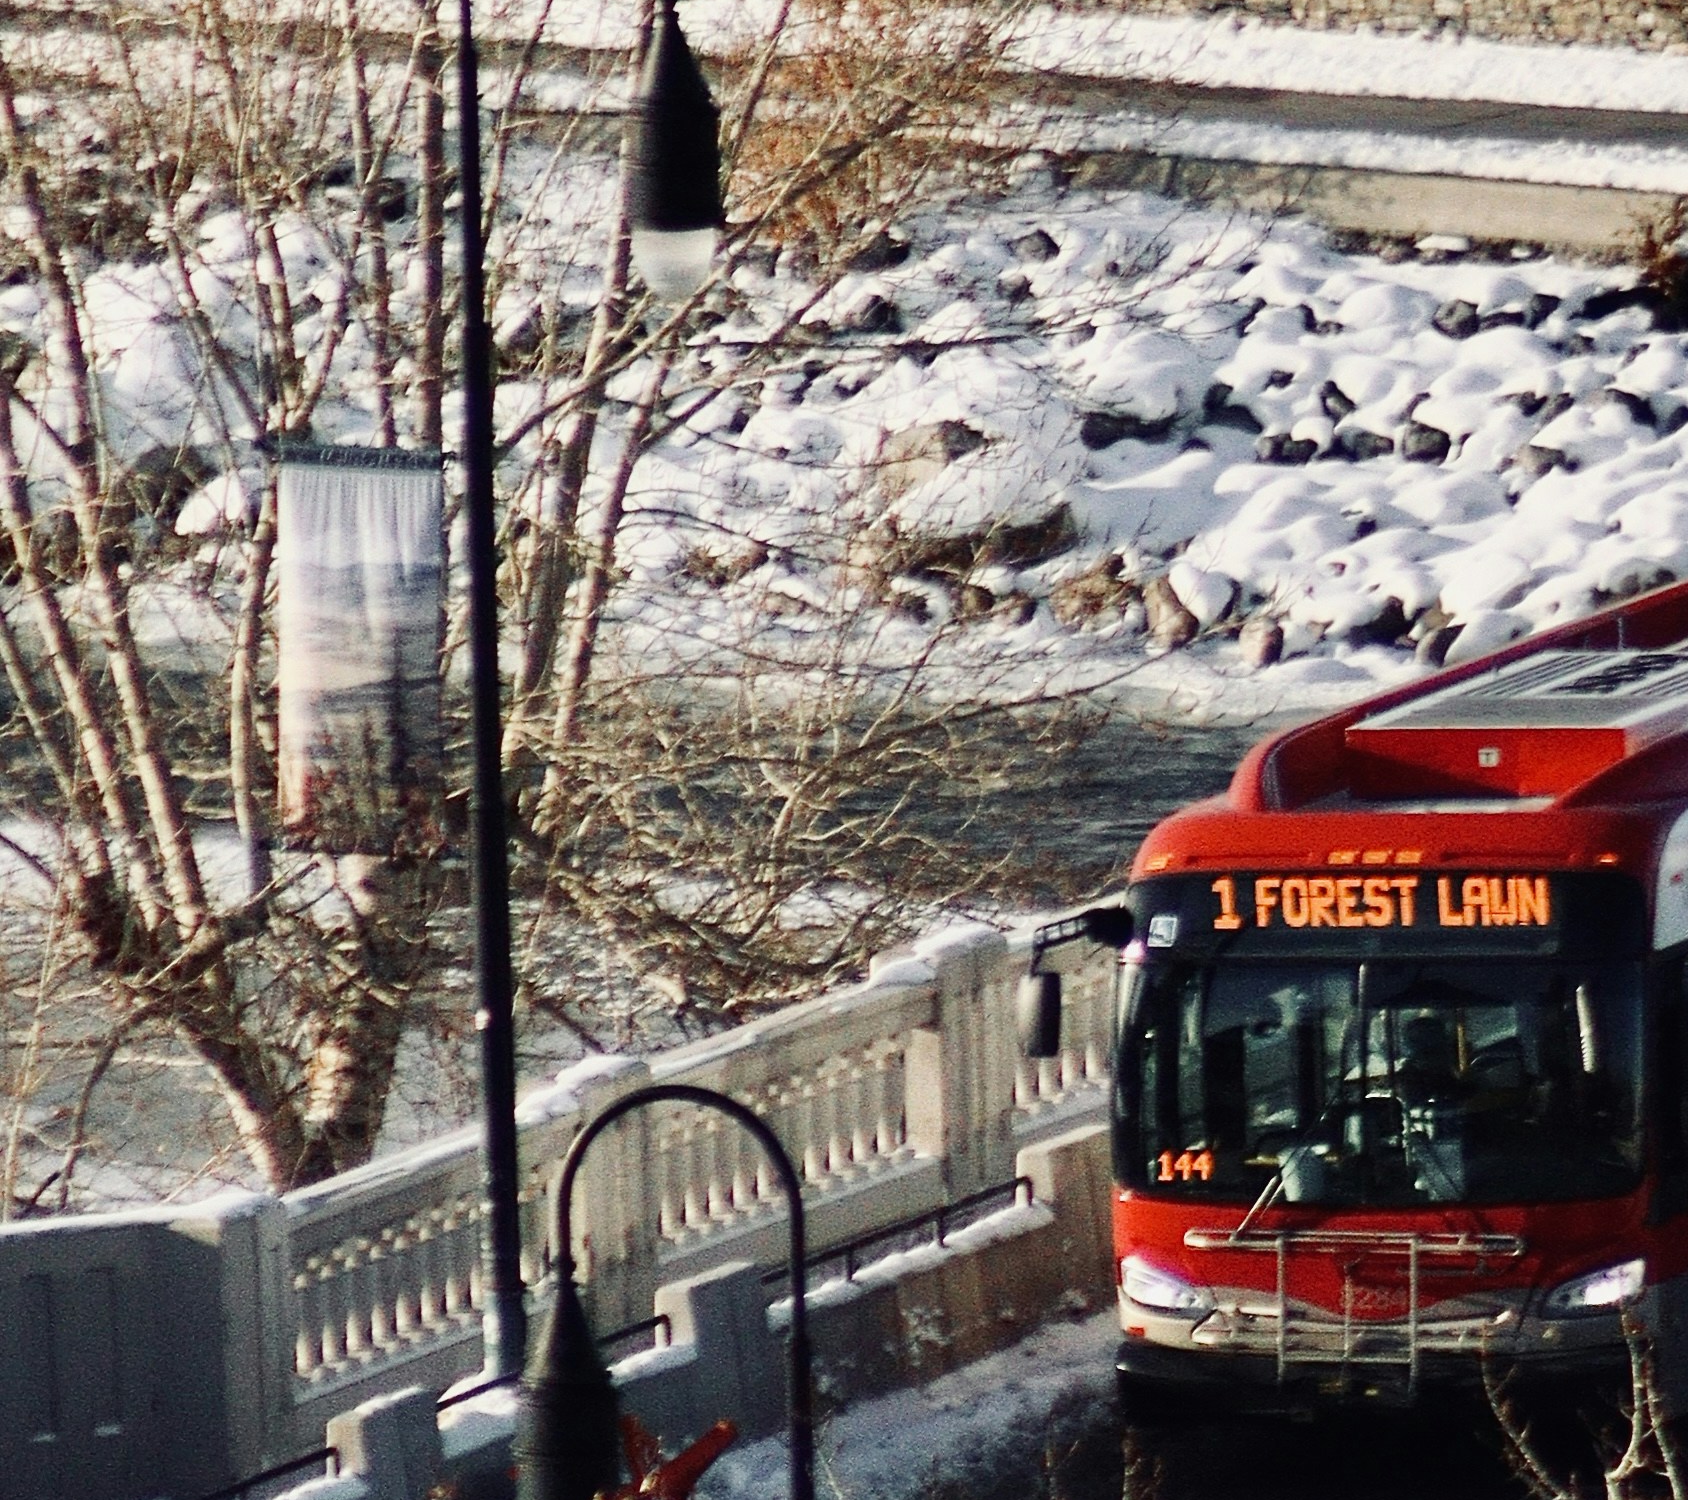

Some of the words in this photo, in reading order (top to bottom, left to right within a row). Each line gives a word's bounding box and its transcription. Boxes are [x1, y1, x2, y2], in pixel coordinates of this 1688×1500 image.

[1212, 877, 1242, 929] 1
[1255, 876, 1418, 928] FOREST
[1438, 876, 1550, 926] LAWN
[1156, 1149, 1214, 1182] 144
